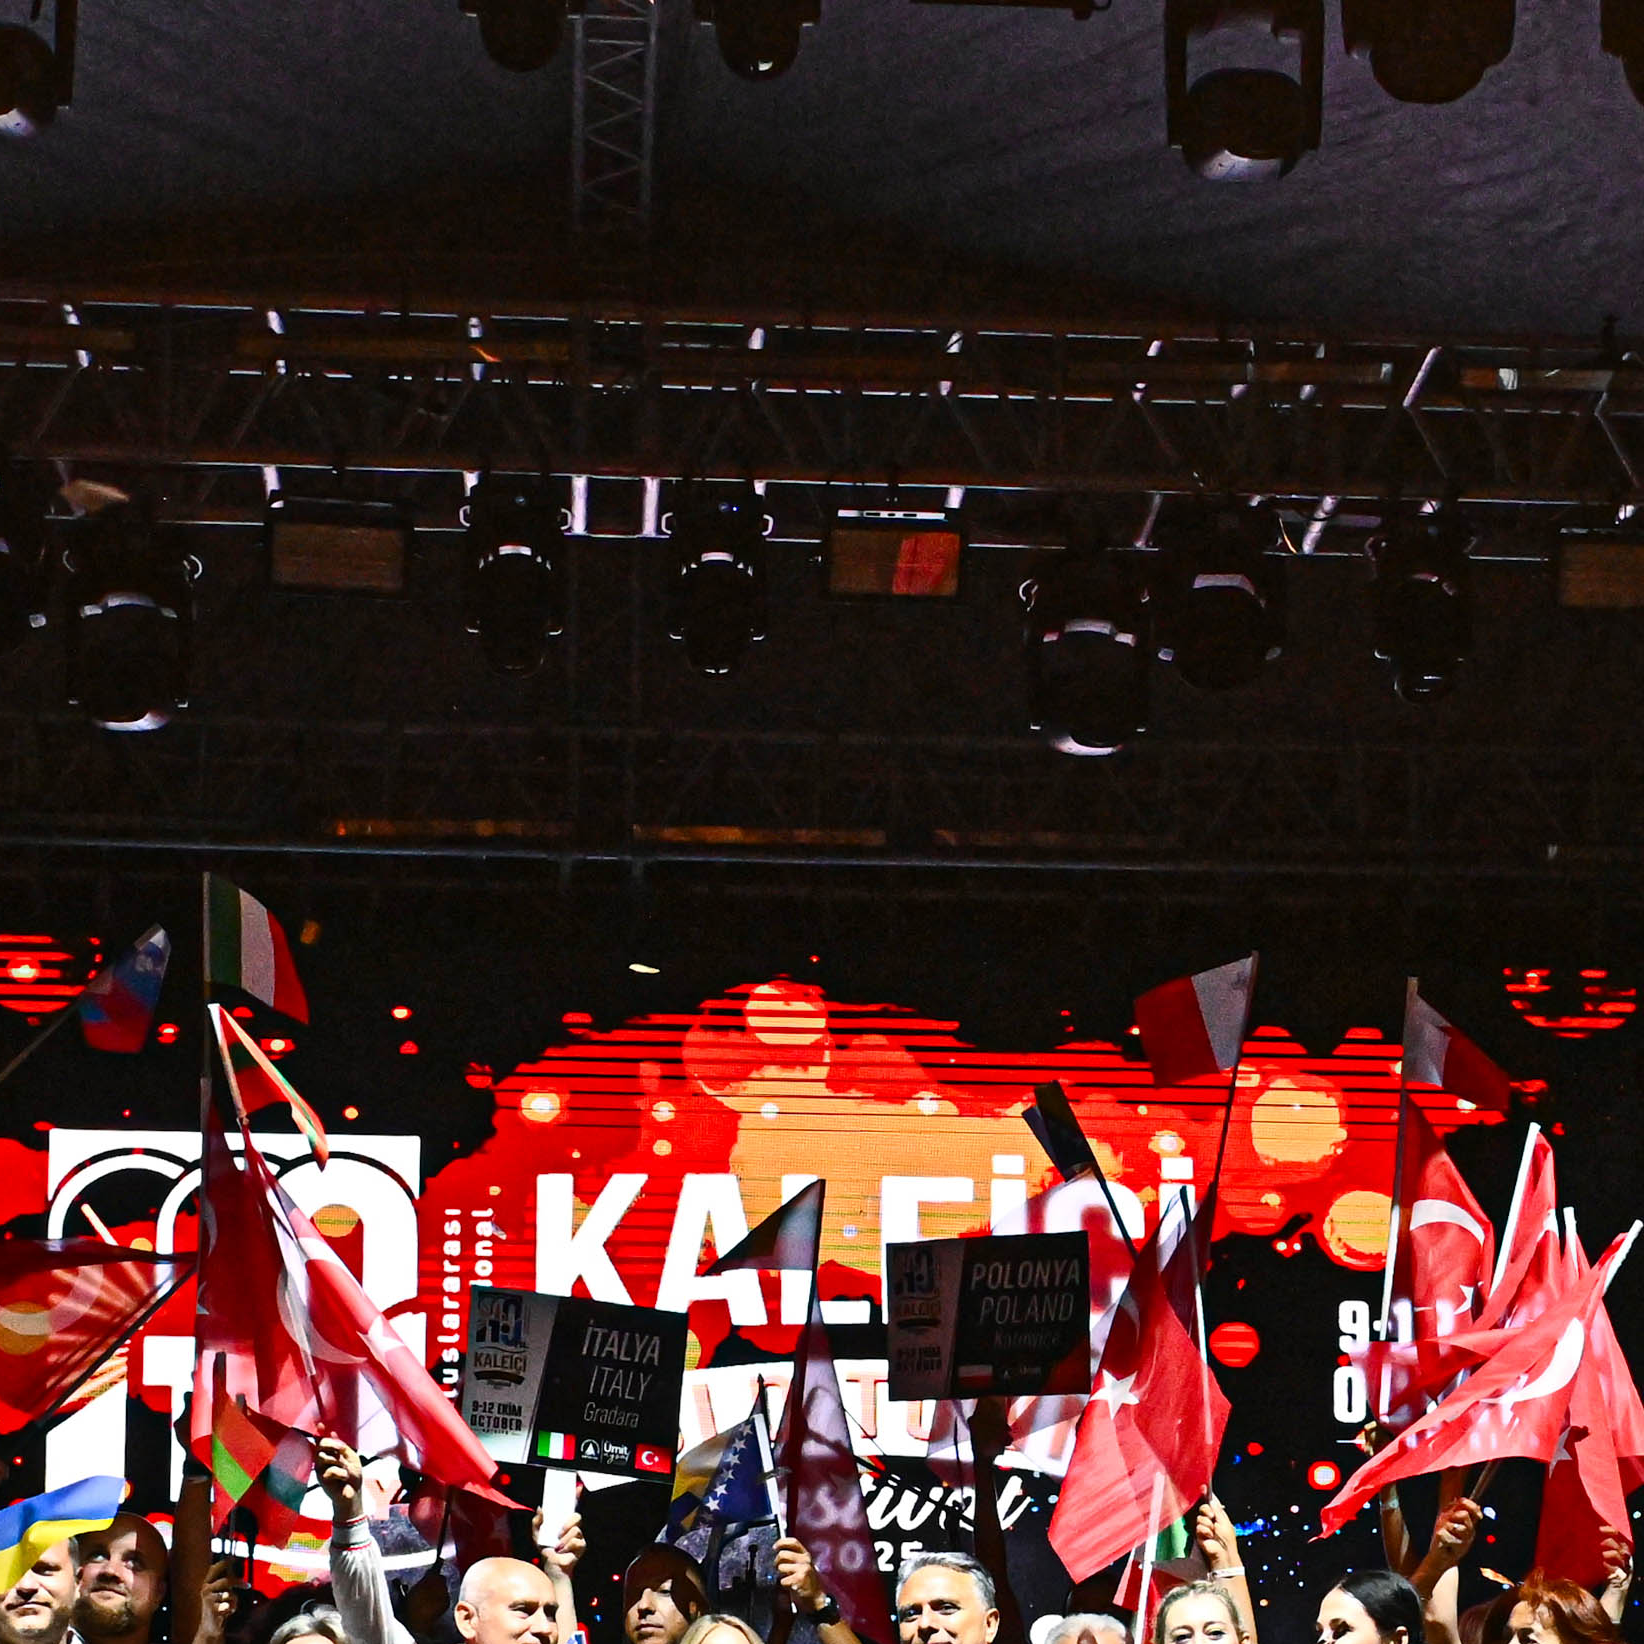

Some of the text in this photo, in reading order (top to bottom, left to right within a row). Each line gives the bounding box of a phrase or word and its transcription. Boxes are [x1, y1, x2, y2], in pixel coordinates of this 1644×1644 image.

[970, 1258, 1082, 1291] POLONYA
[437, 1208, 462, 1399] luslararası
[980, 1292, 1075, 1325] POLAND
[581, 1319, 660, 1366] İTALYA
[589, 1365, 653, 1401] ITALY
[470, 1414, 522, 1431] OCTOBER
[584, 1401, 640, 1428] Gradara
